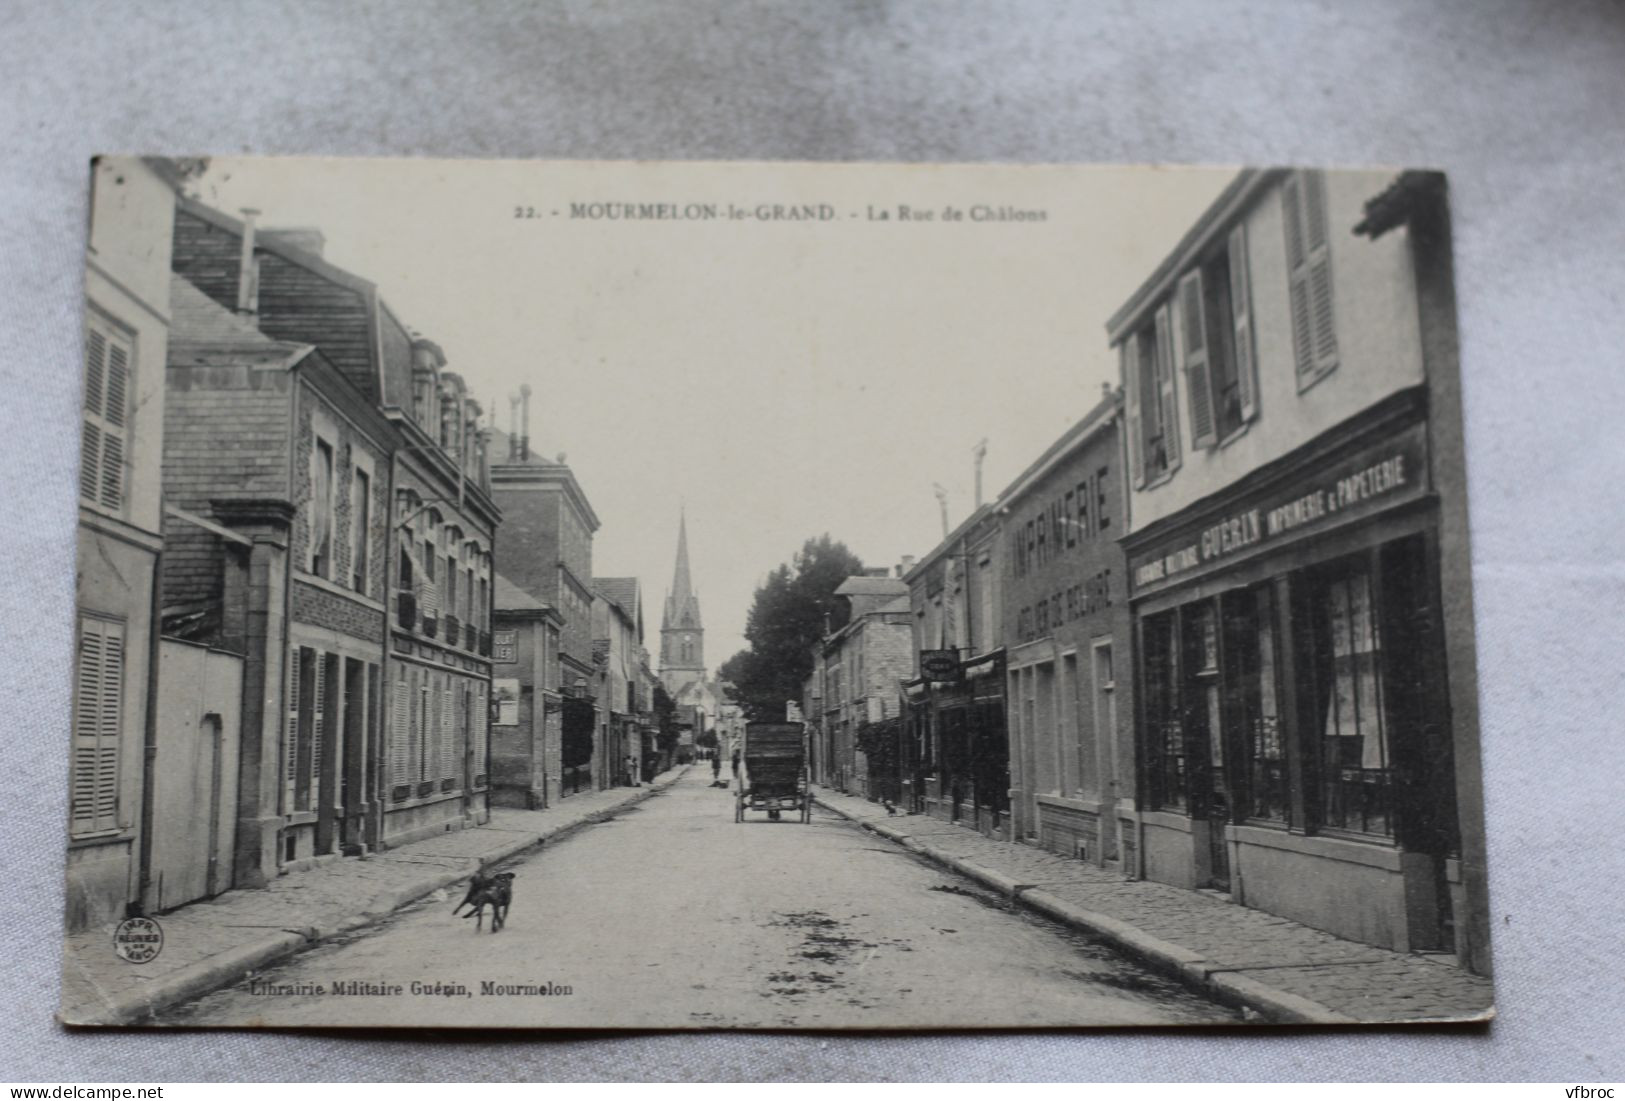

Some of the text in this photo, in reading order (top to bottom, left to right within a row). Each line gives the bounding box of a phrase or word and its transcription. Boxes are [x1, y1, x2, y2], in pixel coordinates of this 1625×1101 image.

[514, 206, 543, 220] 22.
[867, 205, 890, 222] La
[898, 205, 935, 222] Rue
[941, 205, 963, 222] de
[250, 981, 327, 997] Librairie
[331, 981, 403, 997] Militaire
[480, 980, 574, 997] Mourmelon
